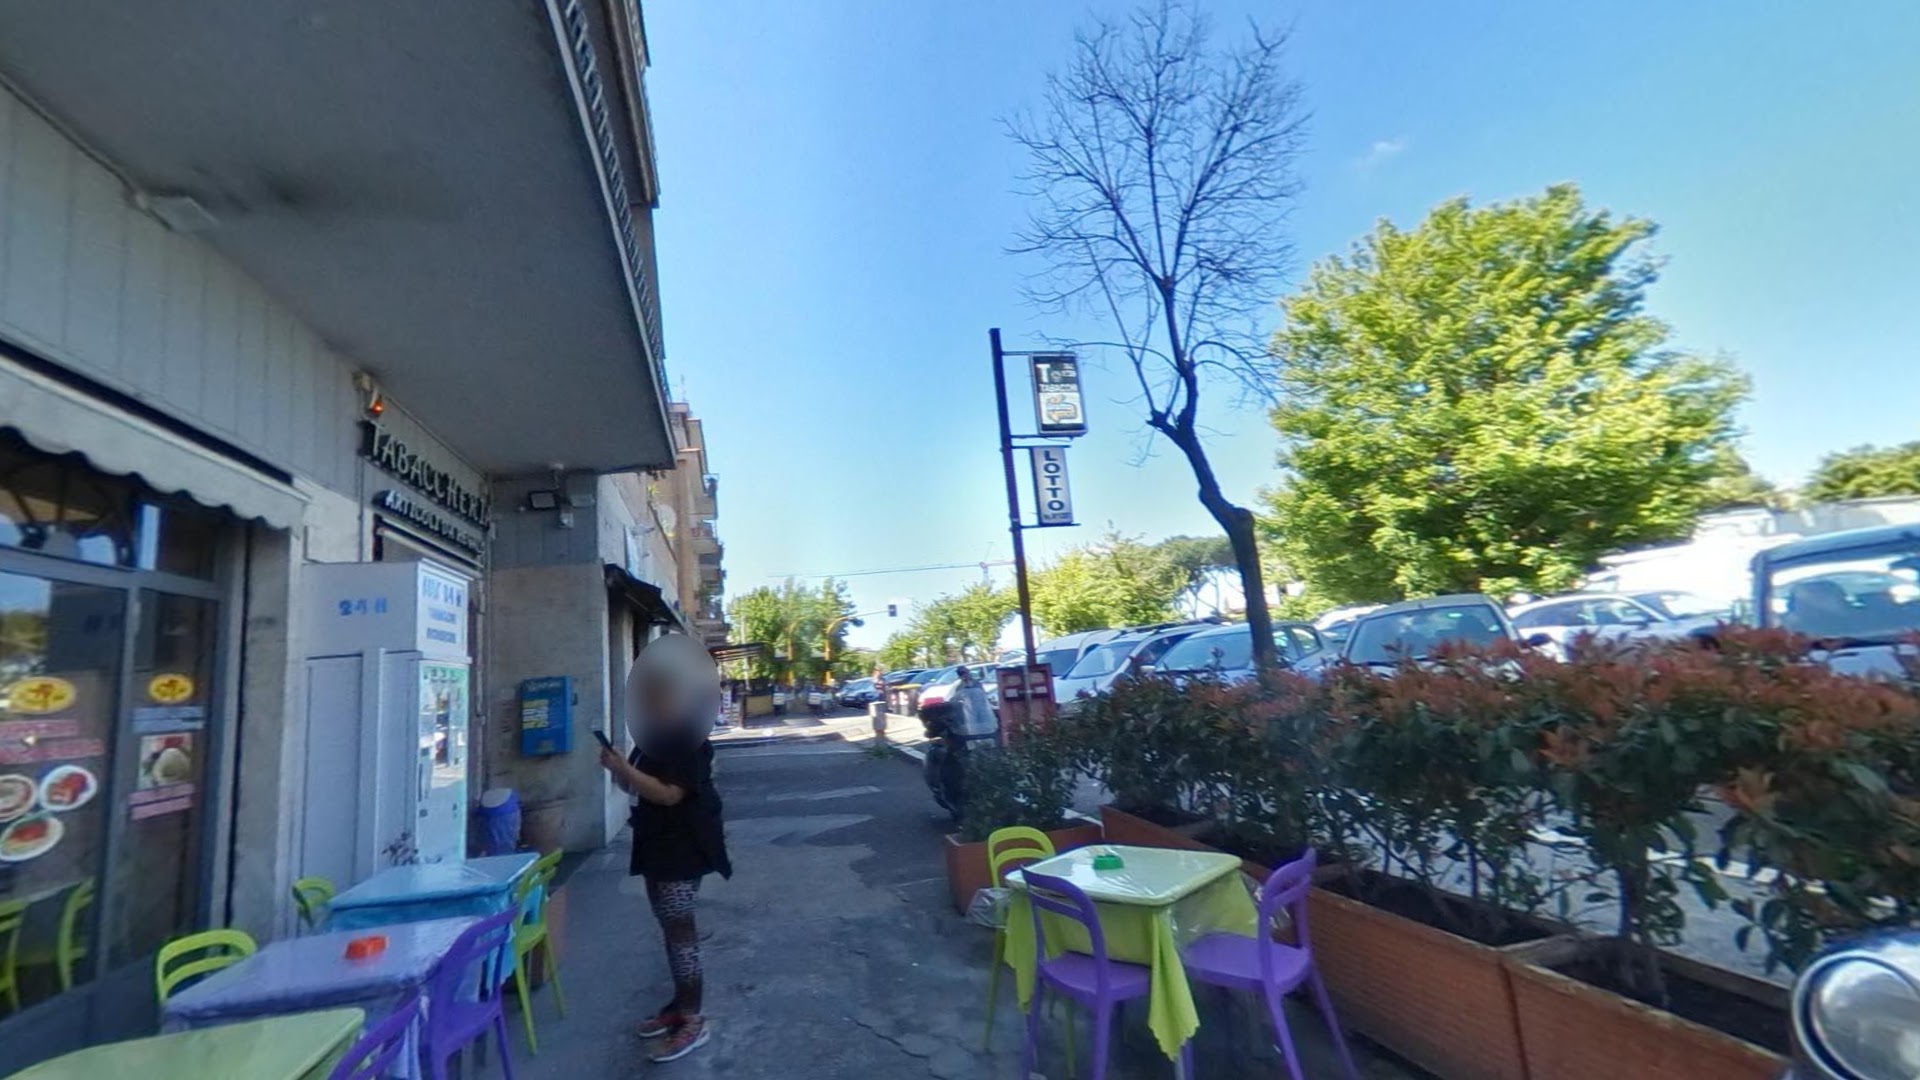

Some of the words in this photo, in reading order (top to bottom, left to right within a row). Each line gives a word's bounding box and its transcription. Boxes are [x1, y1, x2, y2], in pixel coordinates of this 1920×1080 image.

[1036, 363, 1051, 383] T
[368, 419, 493, 528] TABACCHERIA
[1043, 449, 1065, 512] LOTTO
[385, 490, 440, 532] ARTICOLI
